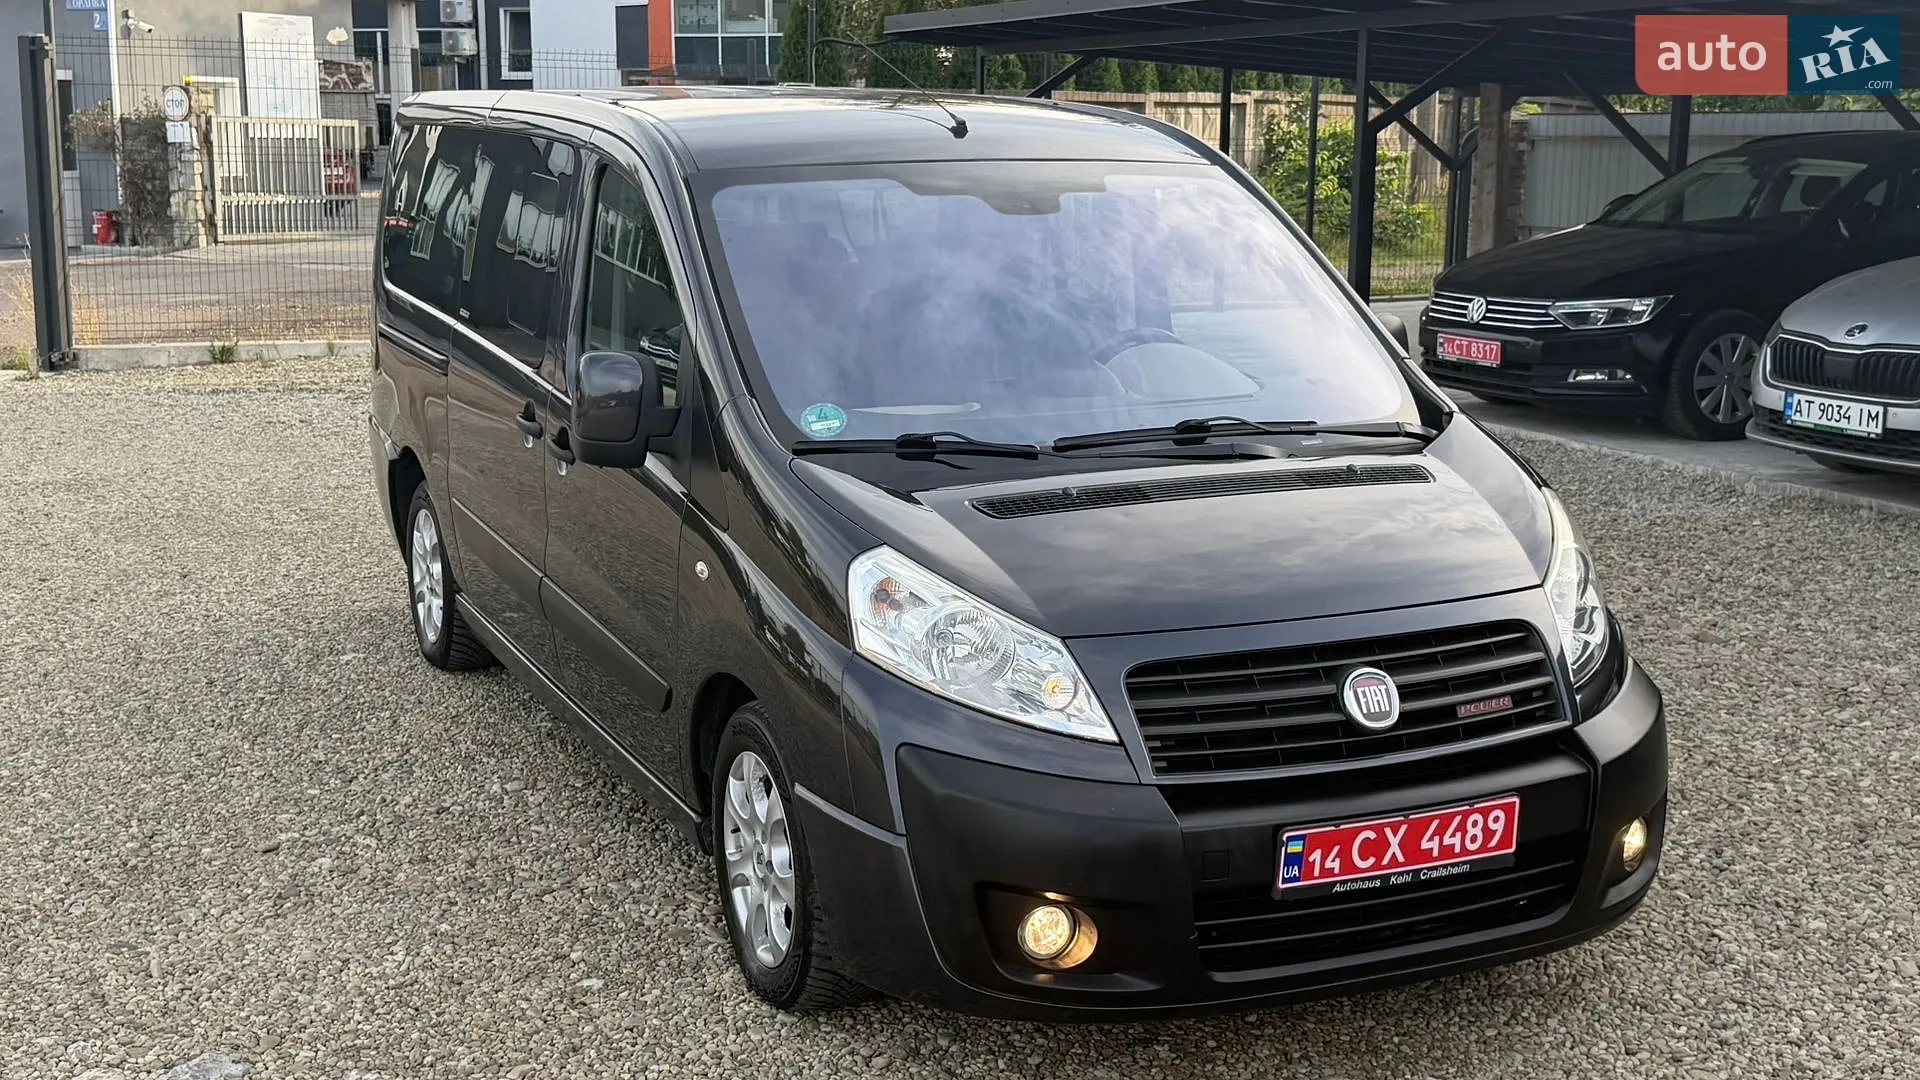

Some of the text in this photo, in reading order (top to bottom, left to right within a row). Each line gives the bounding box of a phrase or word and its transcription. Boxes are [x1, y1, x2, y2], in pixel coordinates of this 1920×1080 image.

[1471, 343, 1497, 360] 8317
[1794, 399, 1880, 429] AT 9034 IM
[1356, 685, 1390, 714] FIAT
[1308, 809, 1506, 877] 14 CX 4489
[1283, 865, 1299, 878] UA
[1332, 863, 1470, 893] Autohaus Kehl Crailsheim
